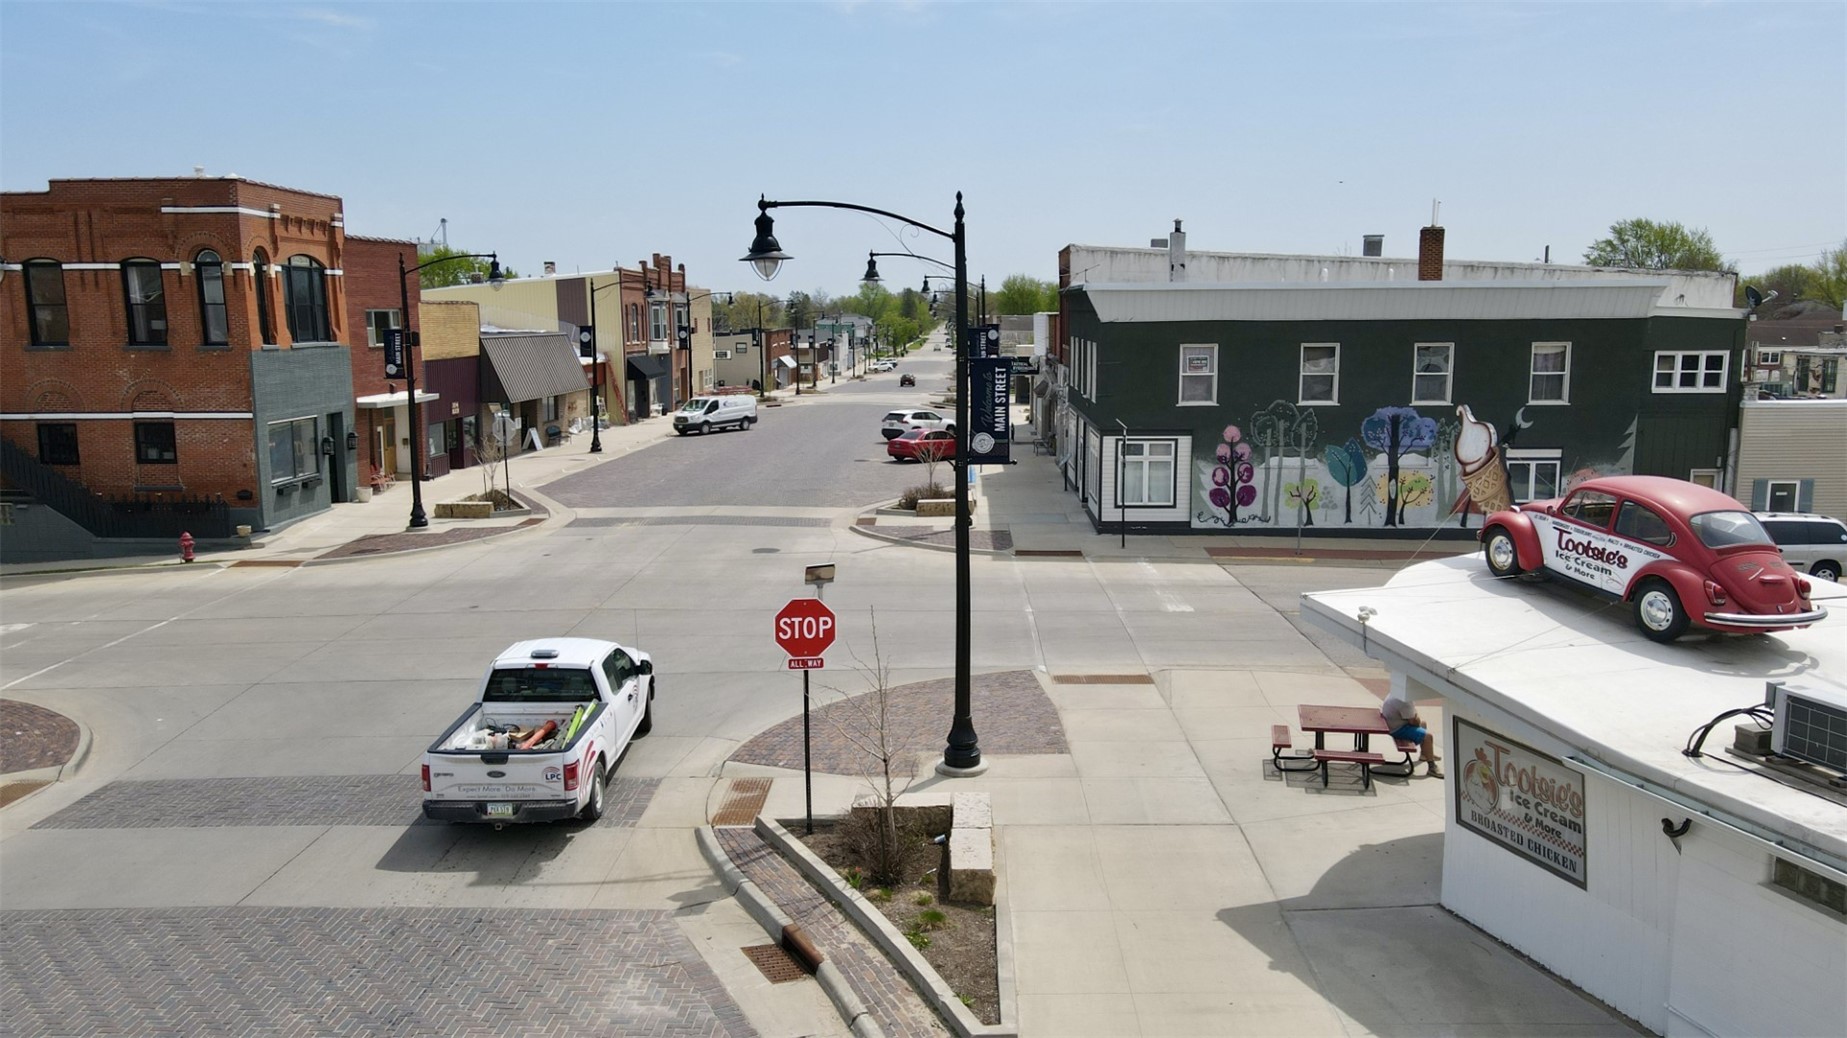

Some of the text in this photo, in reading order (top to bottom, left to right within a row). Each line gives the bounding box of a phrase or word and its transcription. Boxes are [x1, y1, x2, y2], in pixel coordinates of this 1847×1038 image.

[980, 371, 993, 427] Welcome to
[994, 367, 1007, 432] MAIN STREET
[1552, 526, 1628, 569] Tootsie's
[1555, 550, 1612, 576] Ice Cream
[1574, 567, 1595, 580] More
[779, 616, 832, 639] STOP
[1484, 740, 1583, 818] Tootsie's
[1509, 788, 1582, 834] Ice Cream
[1524, 812, 1562, 839] & More
[1471, 810, 1577, 873] BROASTED CHICKEN
